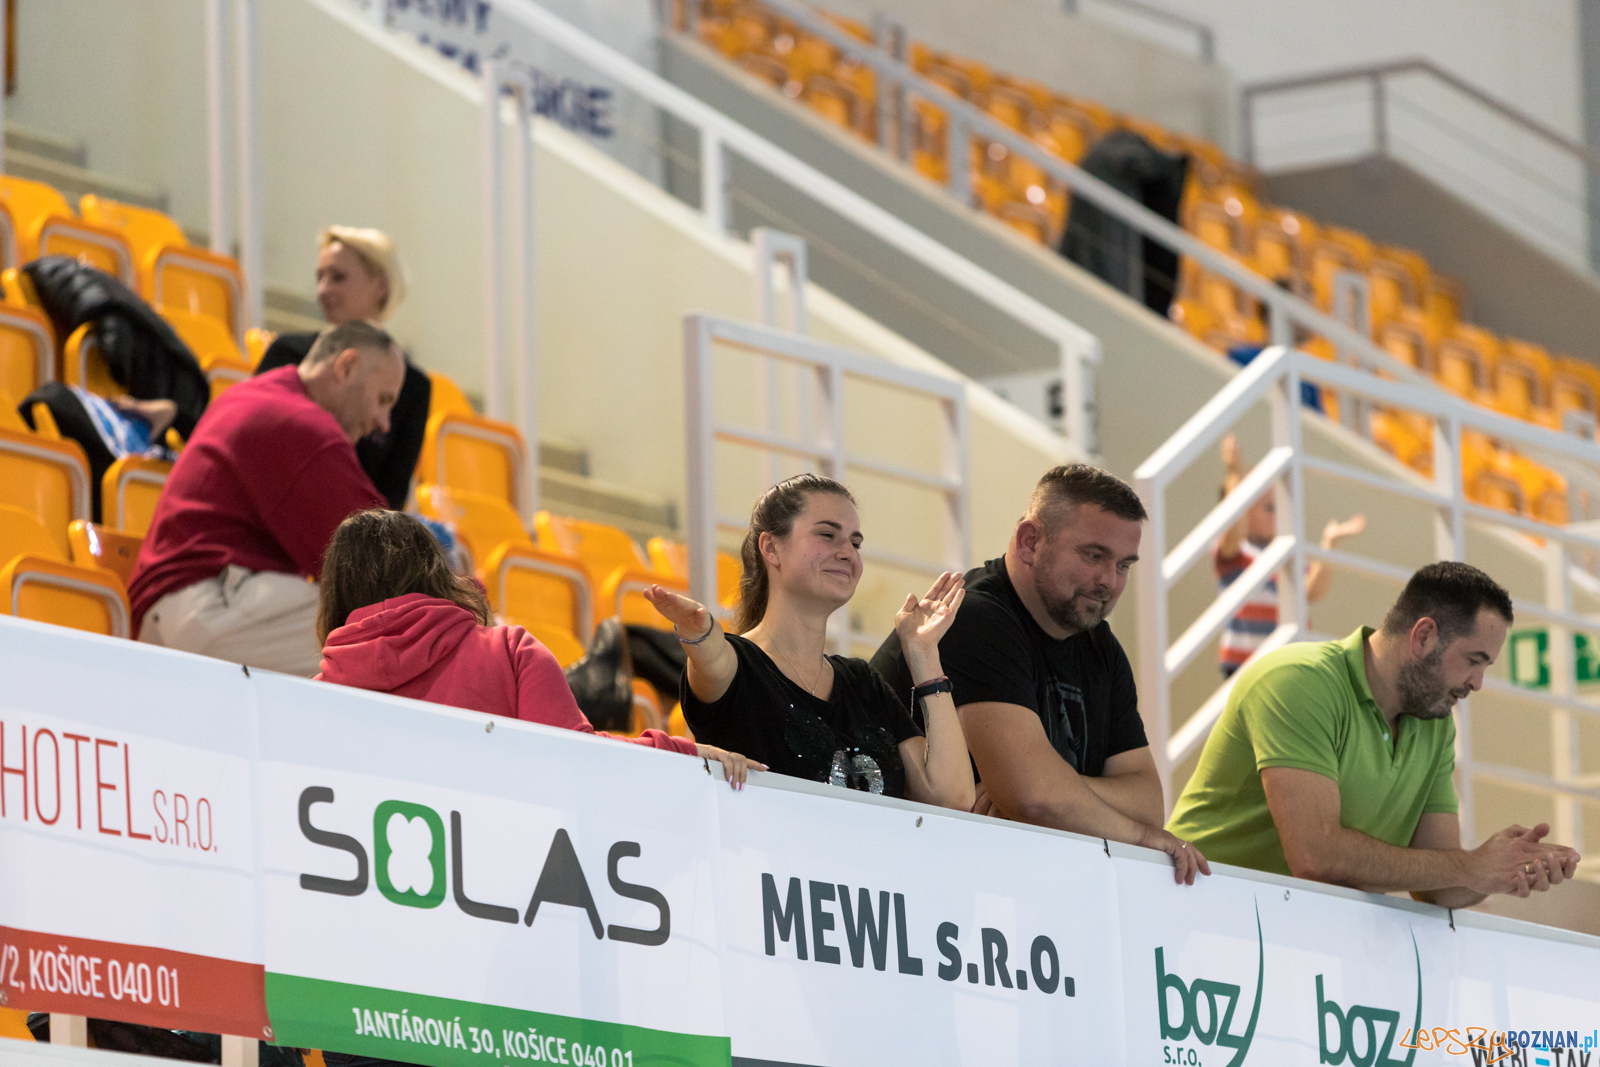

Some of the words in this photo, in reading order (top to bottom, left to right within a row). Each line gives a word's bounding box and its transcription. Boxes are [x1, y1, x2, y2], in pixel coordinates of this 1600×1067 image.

[0, 720, 152, 841] HOTEL
[153, 789, 218, 852] S.R.O.
[298, 785, 671, 947] SOLAS
[761, 872, 924, 977] MEWL
[29, 944, 105, 999] KOŠICE
[108, 959, 152, 1004] 040
[157, 965, 180, 1008] 01
[352, 1007, 467, 1050] JANTÁROVÁ
[468, 1026, 500, 1058] 30,
[502, 1027, 566, 1064] KOŠICE
[571, 1042, 606, 1067] 040
[610, 1048, 634, 1067] 01
[1164, 1045, 1202, 1067] s.r.o.
